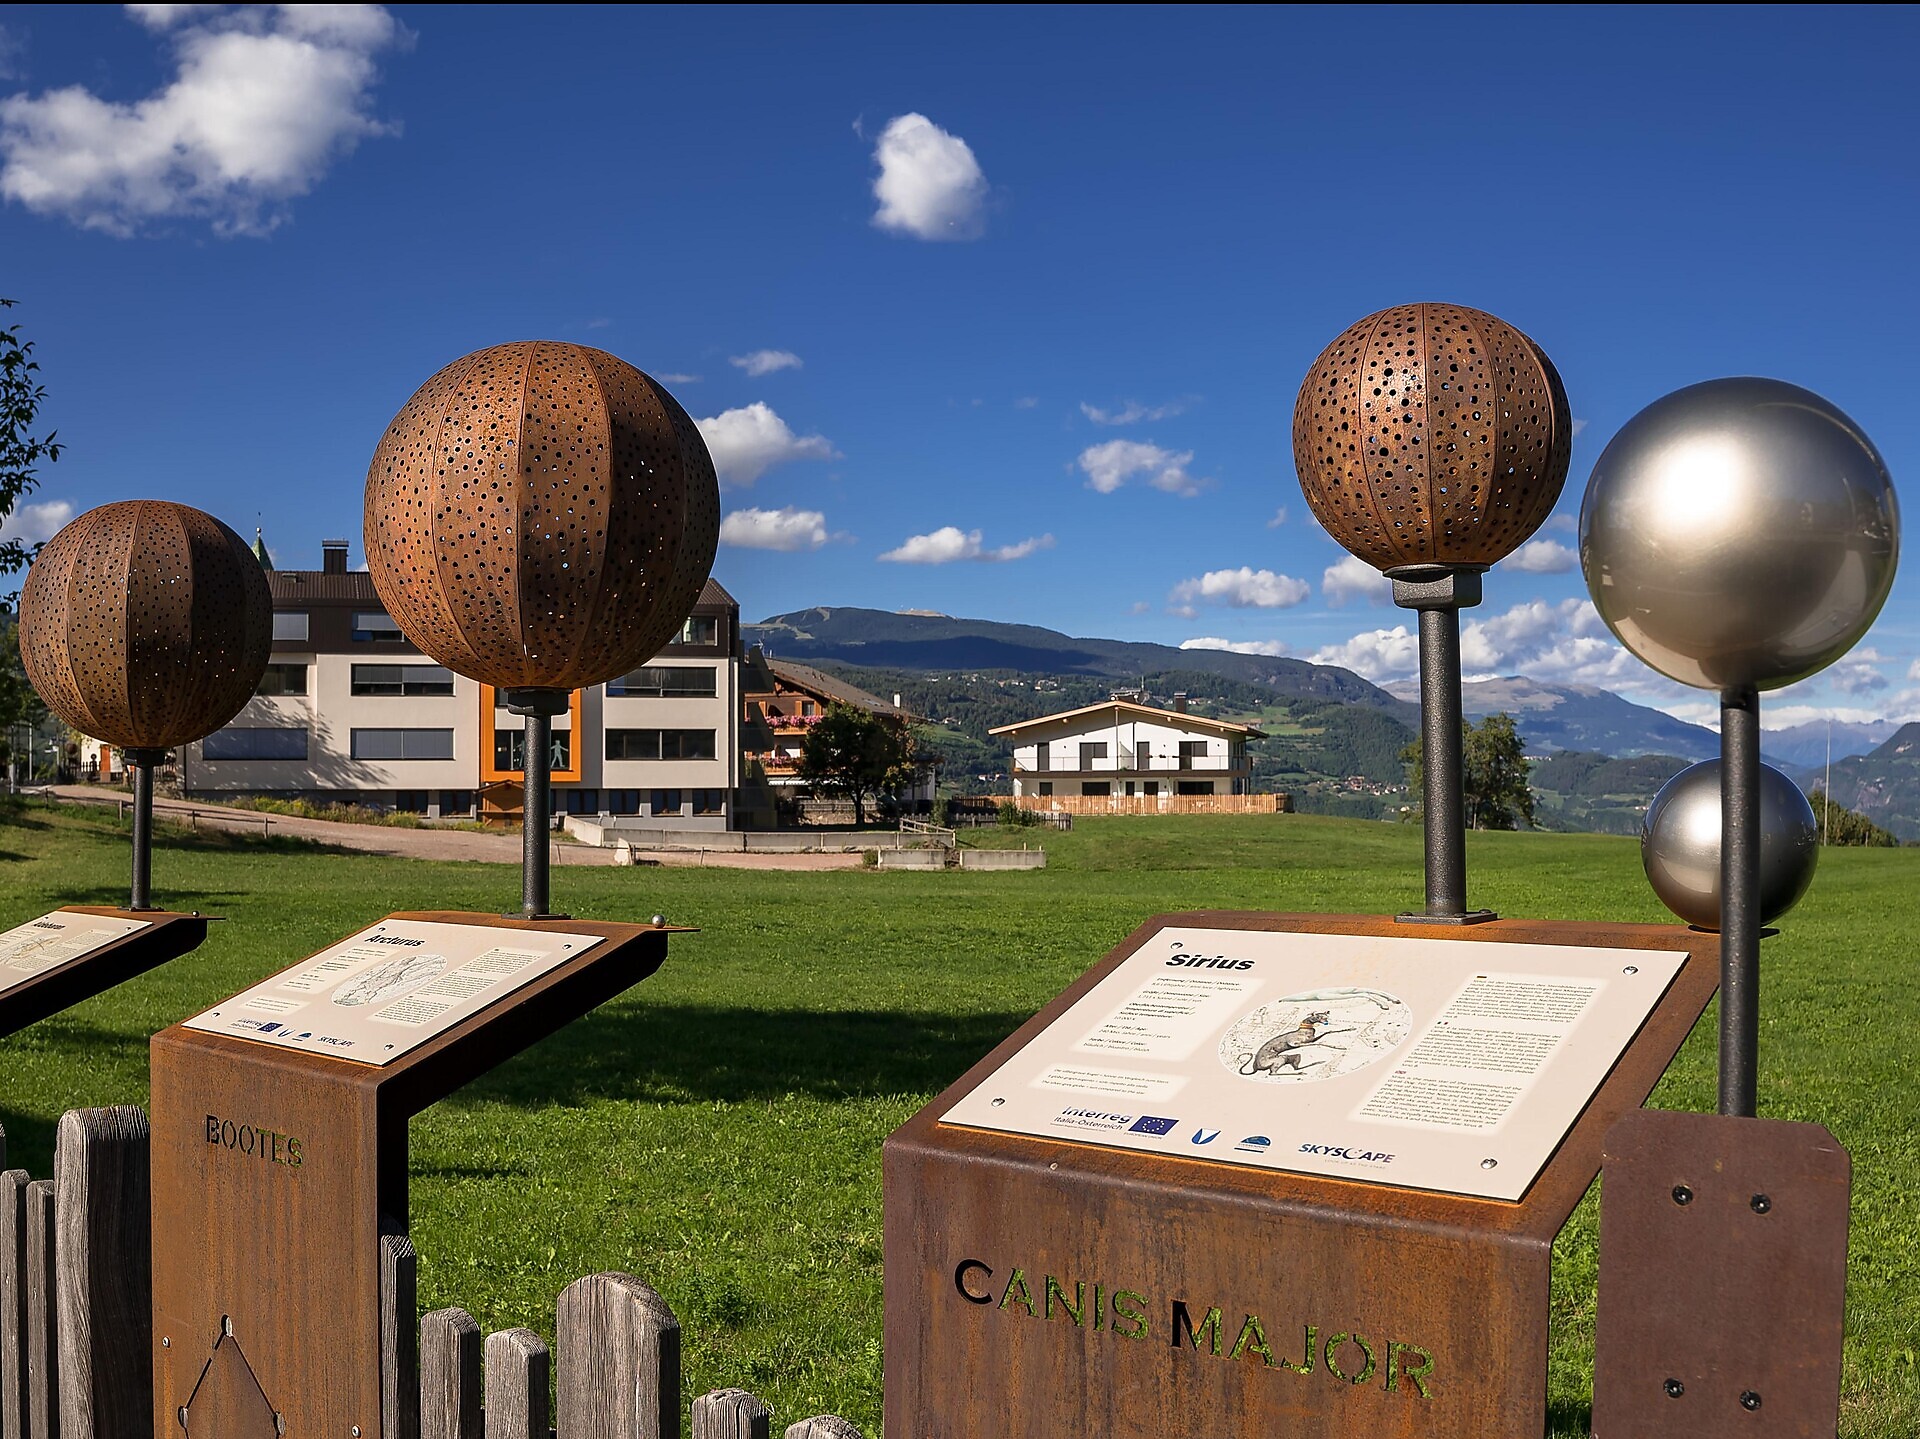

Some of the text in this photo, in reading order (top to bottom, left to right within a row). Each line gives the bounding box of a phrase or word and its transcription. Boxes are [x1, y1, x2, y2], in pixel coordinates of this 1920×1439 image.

[364, 934, 425, 947] Arcturus
[1165, 954, 1255, 970] Sirius
[1053, 1116, 1123, 1131] Italia-Österreich
[1061, 1105, 1133, 1124] Interreg
[206, 1114, 303, 1168] BOOTES
[1298, 1143, 1396, 1164] SKYSCAPE
[954, 1258, 1435, 1400] CANIS MAJOR
